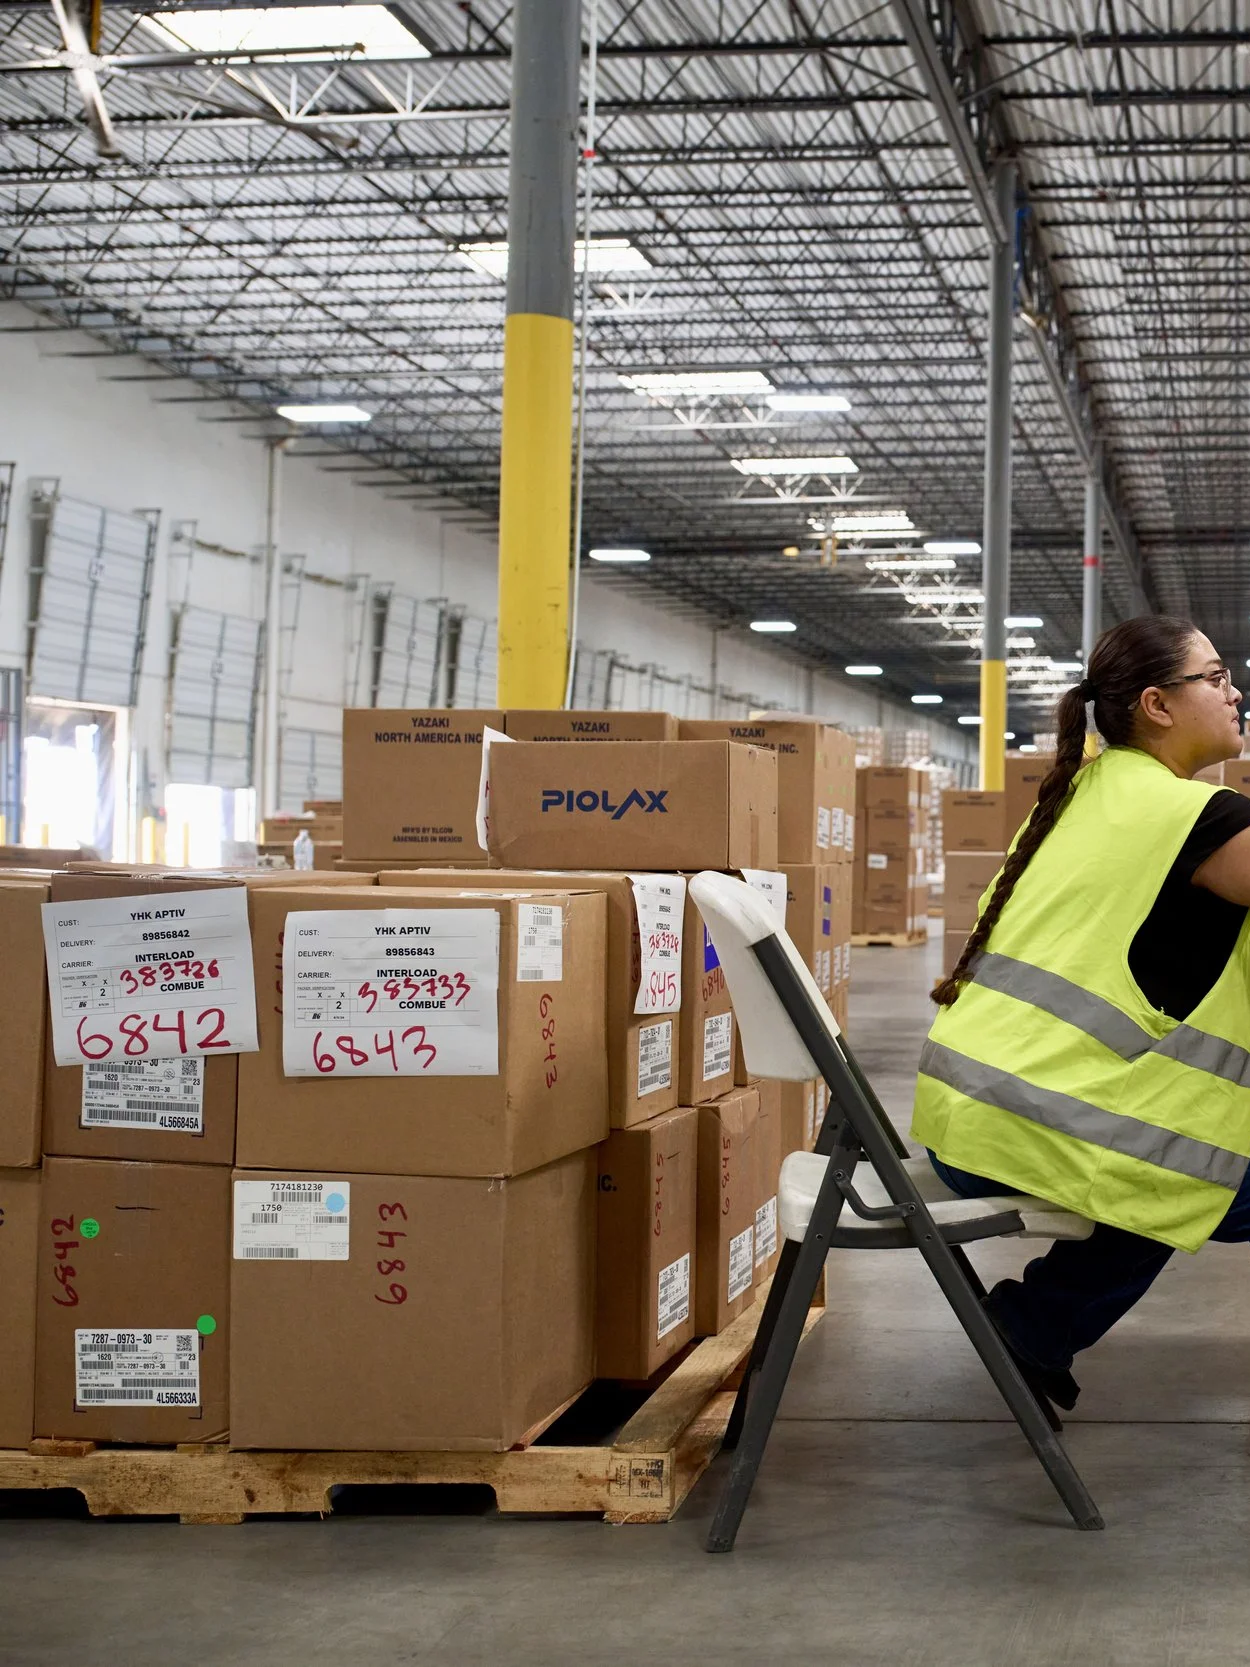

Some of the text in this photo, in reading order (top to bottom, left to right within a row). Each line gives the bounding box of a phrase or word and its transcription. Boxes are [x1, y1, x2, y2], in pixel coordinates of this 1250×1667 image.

[412, 718, 449, 727] YAZAKI
[571, 722, 609, 732] YAZAKI
[375, 732, 411, 742] NORTH
[415, 733, 461, 743] AMERICA
[730, 728, 765, 738] YAZAKI
[779, 744, 798, 753] INC.
[542, 789, 668, 820] PIOLAX
[131, 912, 152, 920] YHK
[155, 909, 185, 918] APTIV
[143, 930, 190, 940] 89856842
[375, 927, 396, 935] YHK
[136, 951, 194, 962] INTERLOAD
[386, 948, 434, 956] 89856843
[120, 959, 219, 994] 383726
[377, 969, 437, 977] INTERLOAD
[161, 981, 204, 991] COMBUE
[100, 988, 105, 996] 2
[336, 1001, 341, 1009] 2
[399, 1001, 446, 1009] COMBUE
[77, 1008, 231, 1059] 6842
[540, 994, 557, 1088] 6843
[313, 1026, 436, 1072] 6843
[160, 1116, 198, 1129] 4L566845A
[375, 1203, 407, 1304] 6843
[51, 1215, 79, 1306] 6842
[157, 1393, 197, 1403] 4L566333A
